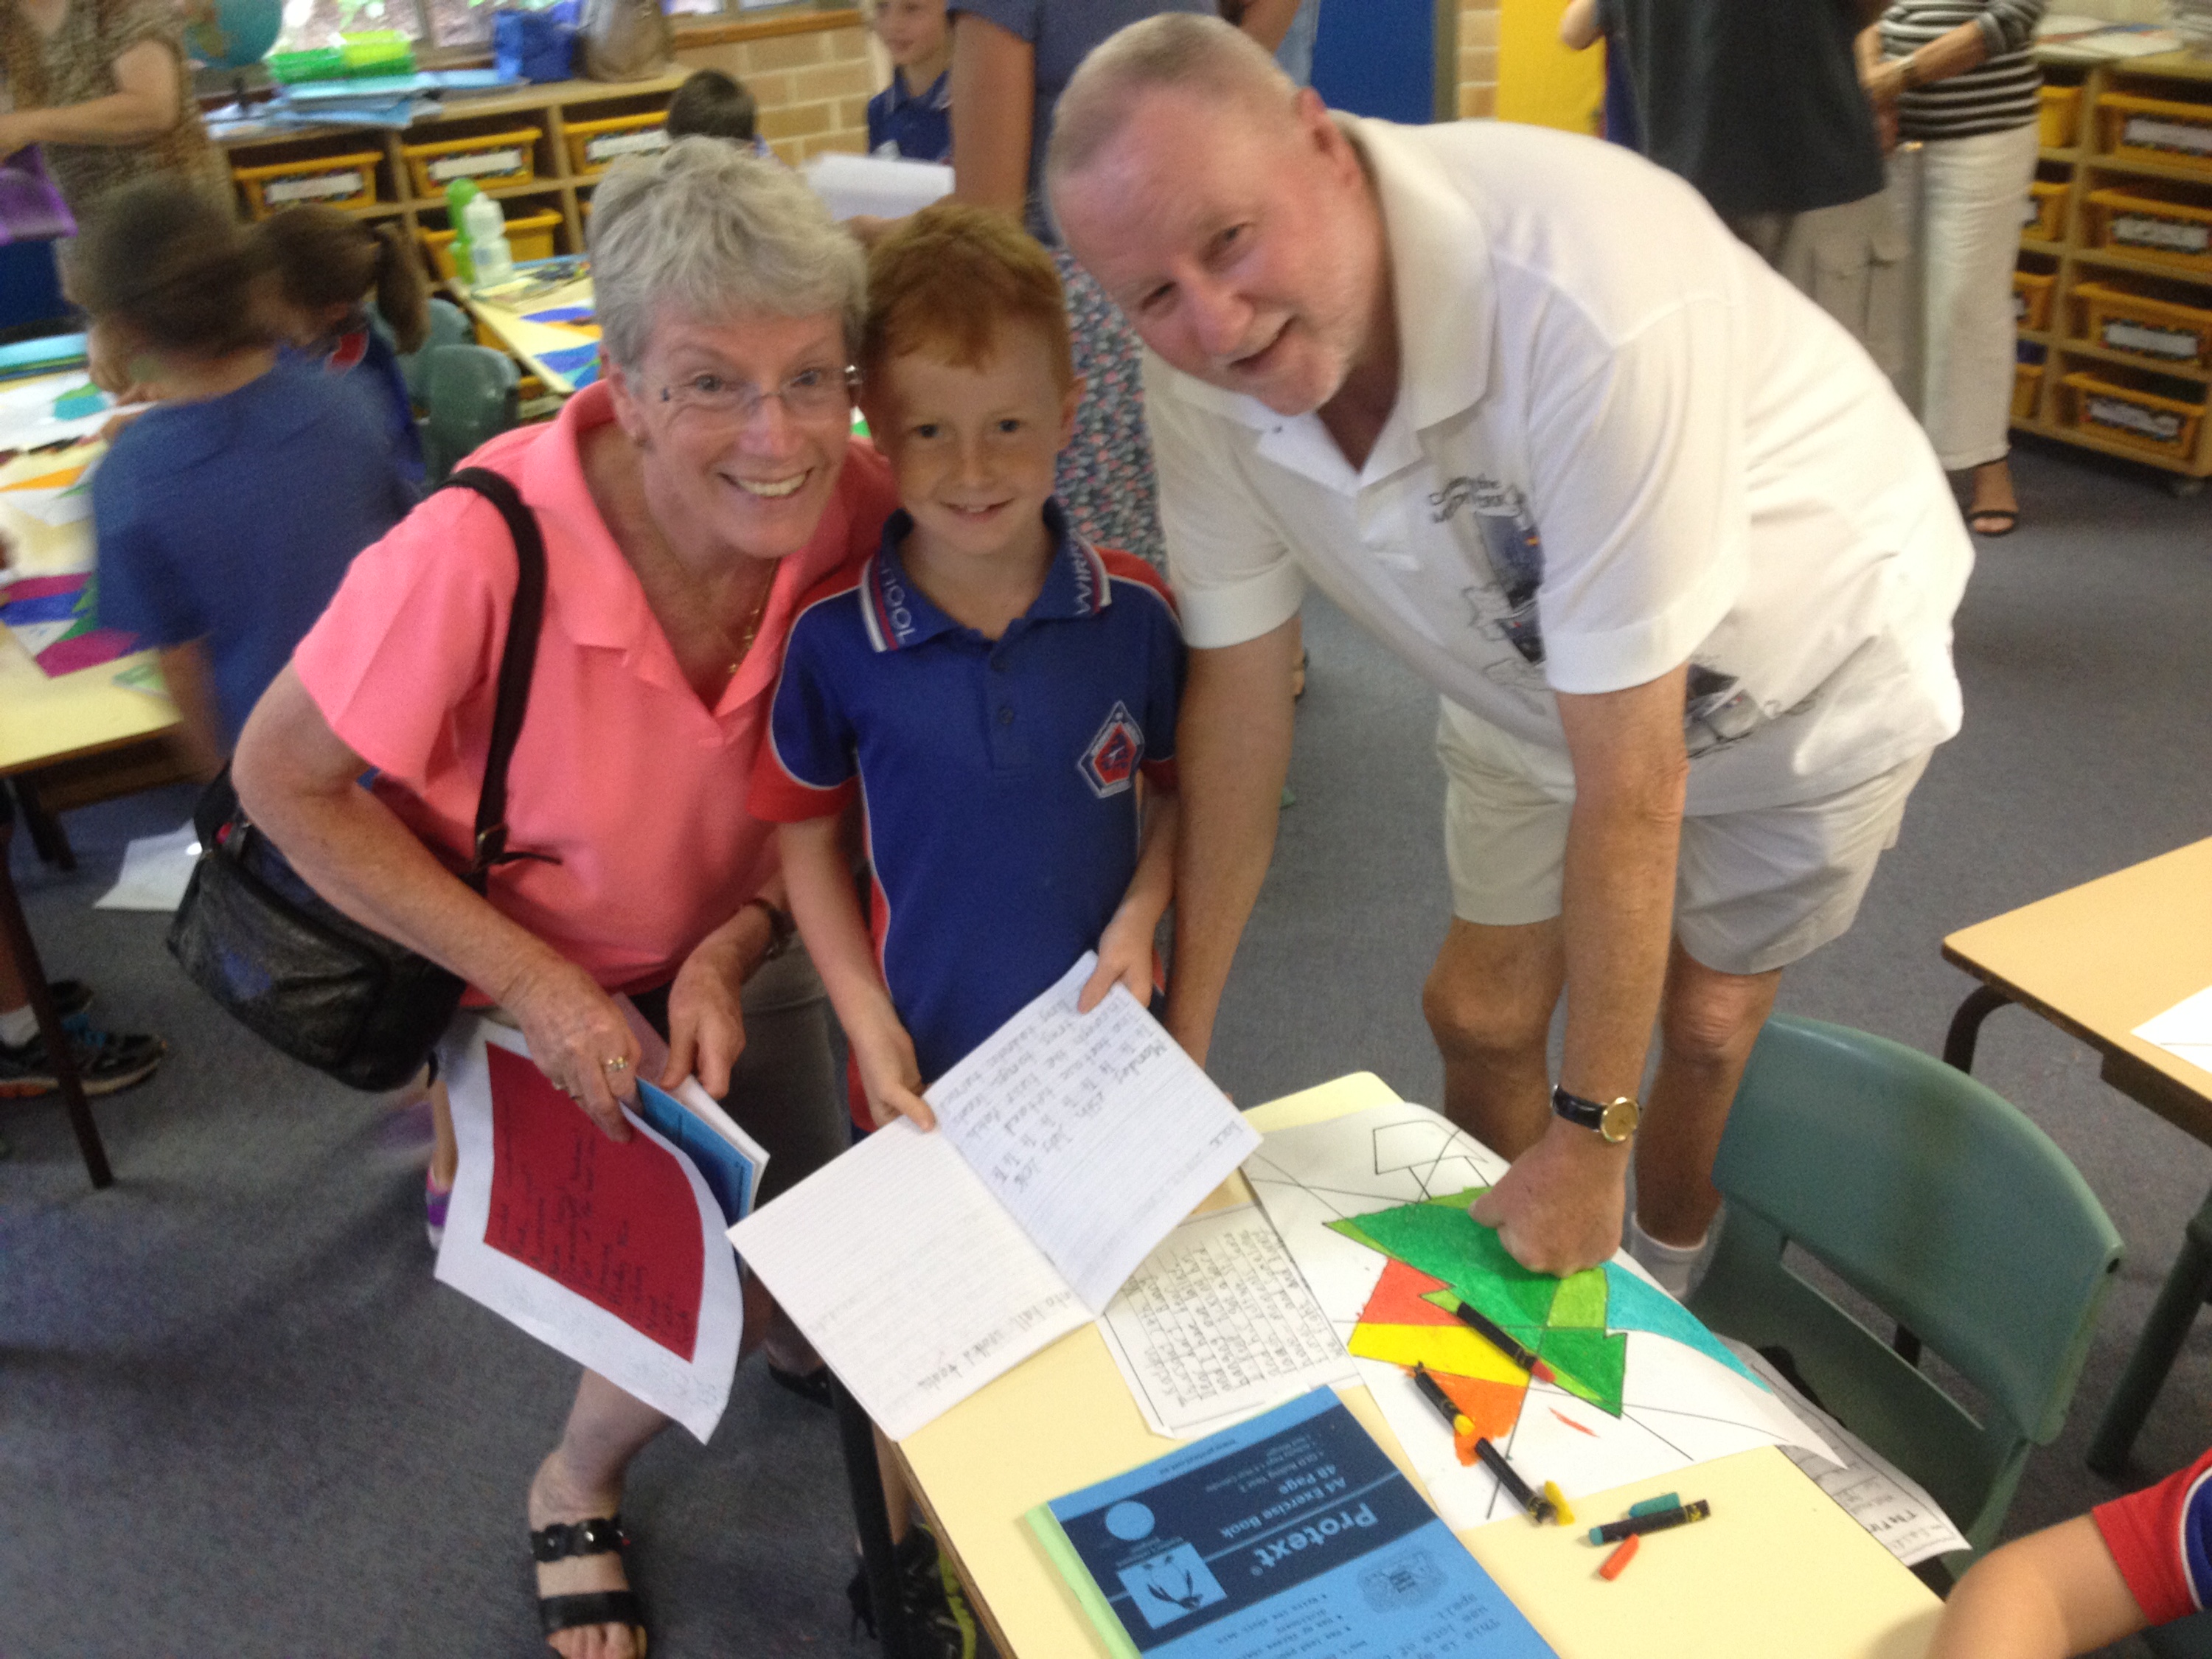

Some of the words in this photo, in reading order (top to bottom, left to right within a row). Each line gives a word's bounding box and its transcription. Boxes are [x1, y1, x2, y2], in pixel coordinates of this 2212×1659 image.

[1276, 1470, 1317, 1497] Page
[1315, 1461, 1338, 1480] 48
[1324, 1475, 1346, 1494] A4
[1260, 1486, 1324, 1521] Exercise
[1219, 1514, 1262, 1540] Book
